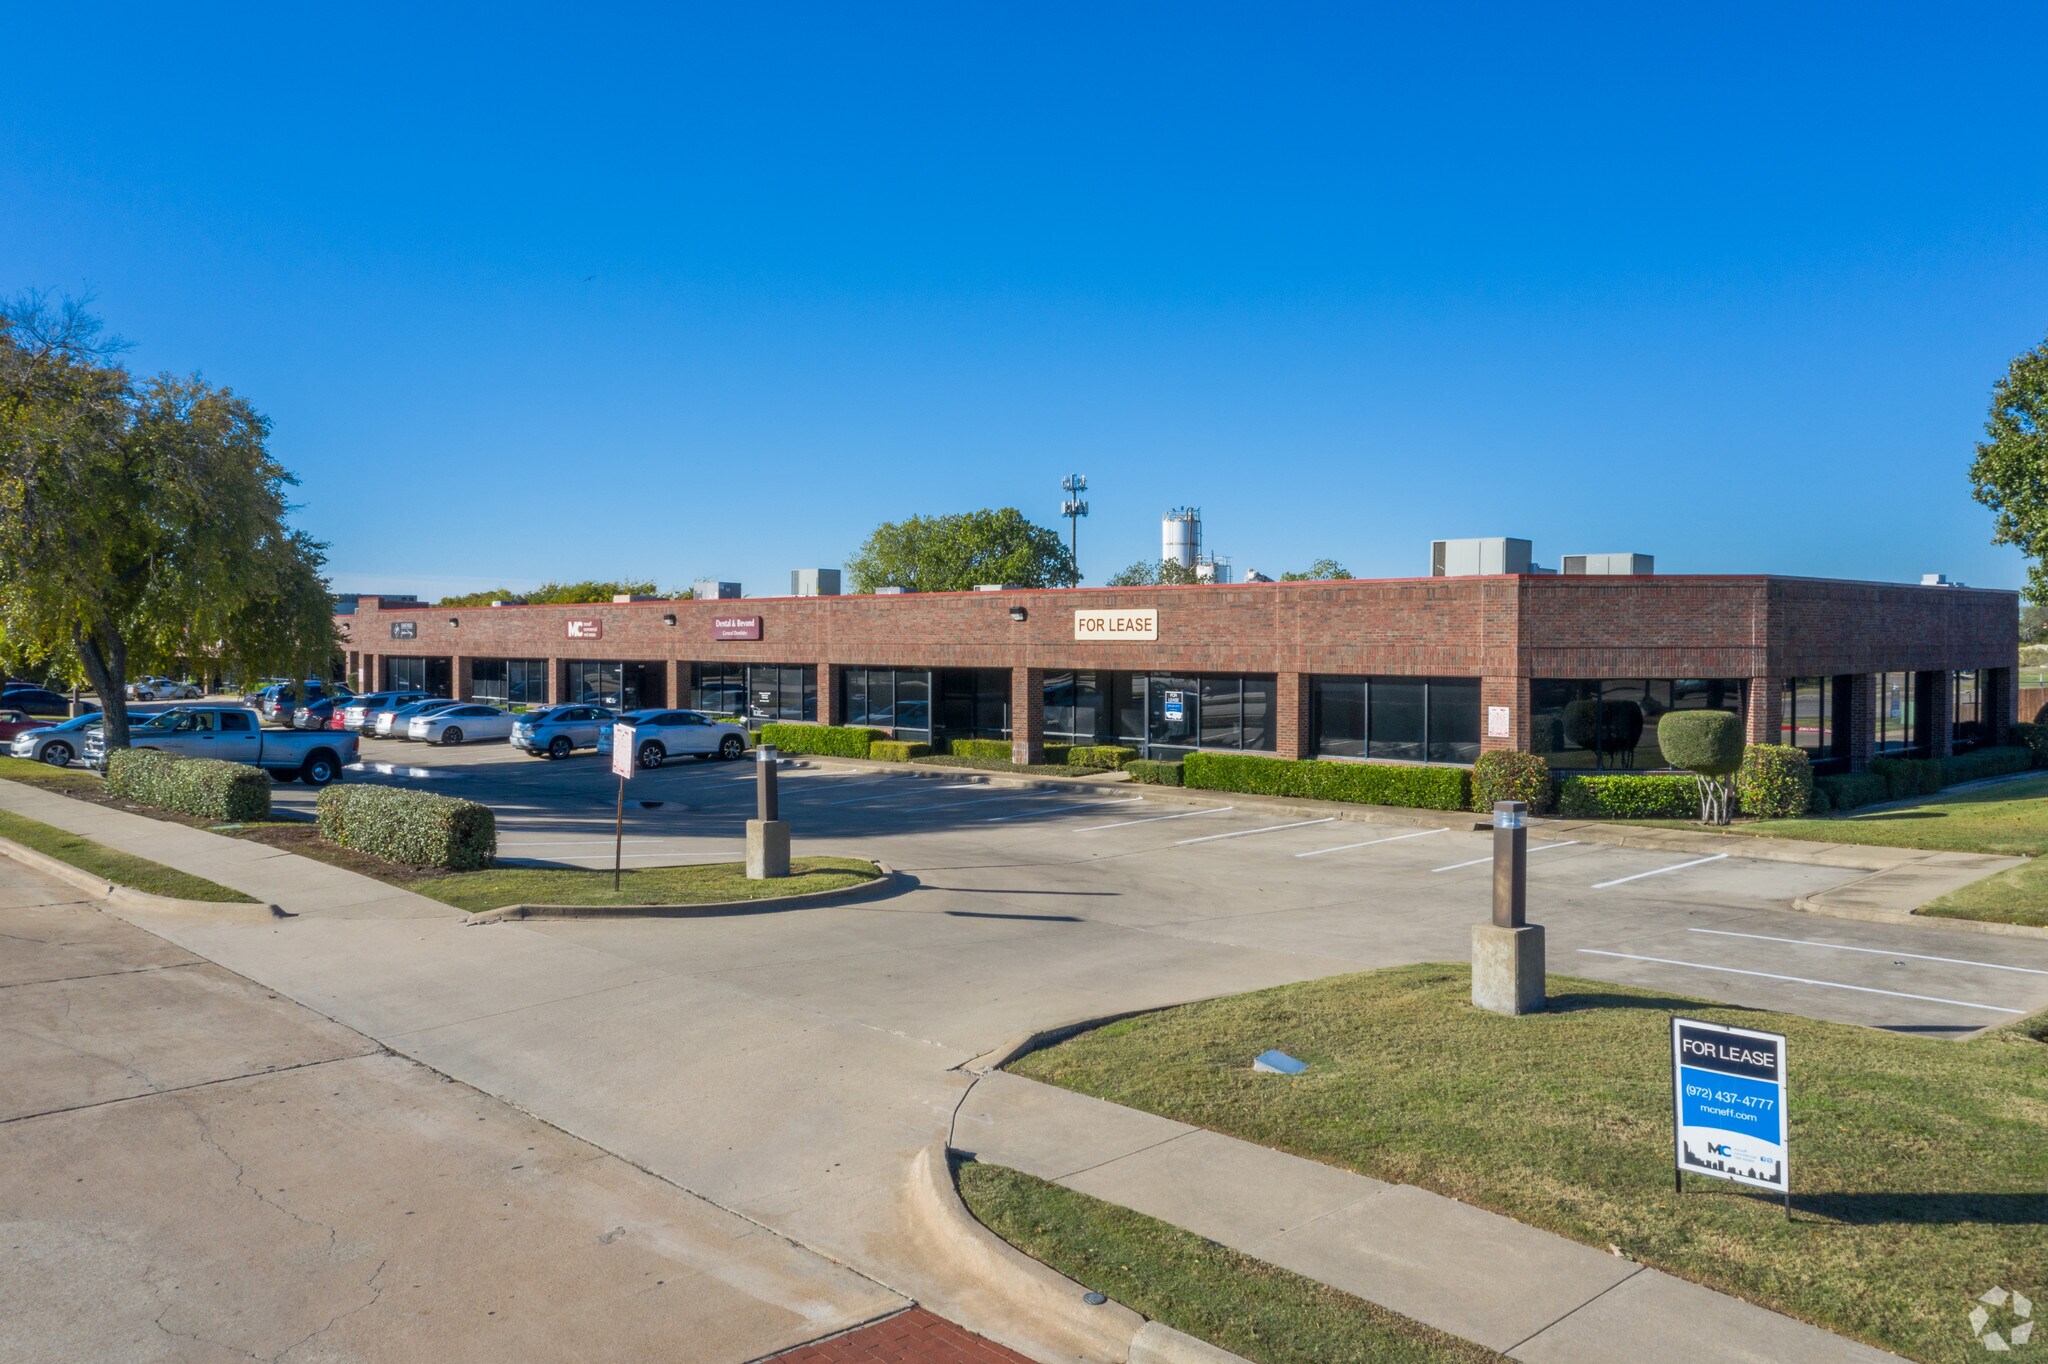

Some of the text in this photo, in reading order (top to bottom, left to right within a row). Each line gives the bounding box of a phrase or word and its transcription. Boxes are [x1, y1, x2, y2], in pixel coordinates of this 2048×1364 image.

[568, 621, 583, 637] MC
[715, 619, 731, 627] Dental
[732, 619, 736, 627] &
[1079, 618, 1152, 632] FOR LEASE
[1682, 1038, 1775, 1067] FOR LEASE
[1686, 1084, 1774, 1110] (972) 437-4777
[1700, 1105, 1758, 1122] mcneff.com
[1707, 1141, 1732, 1158] MC
